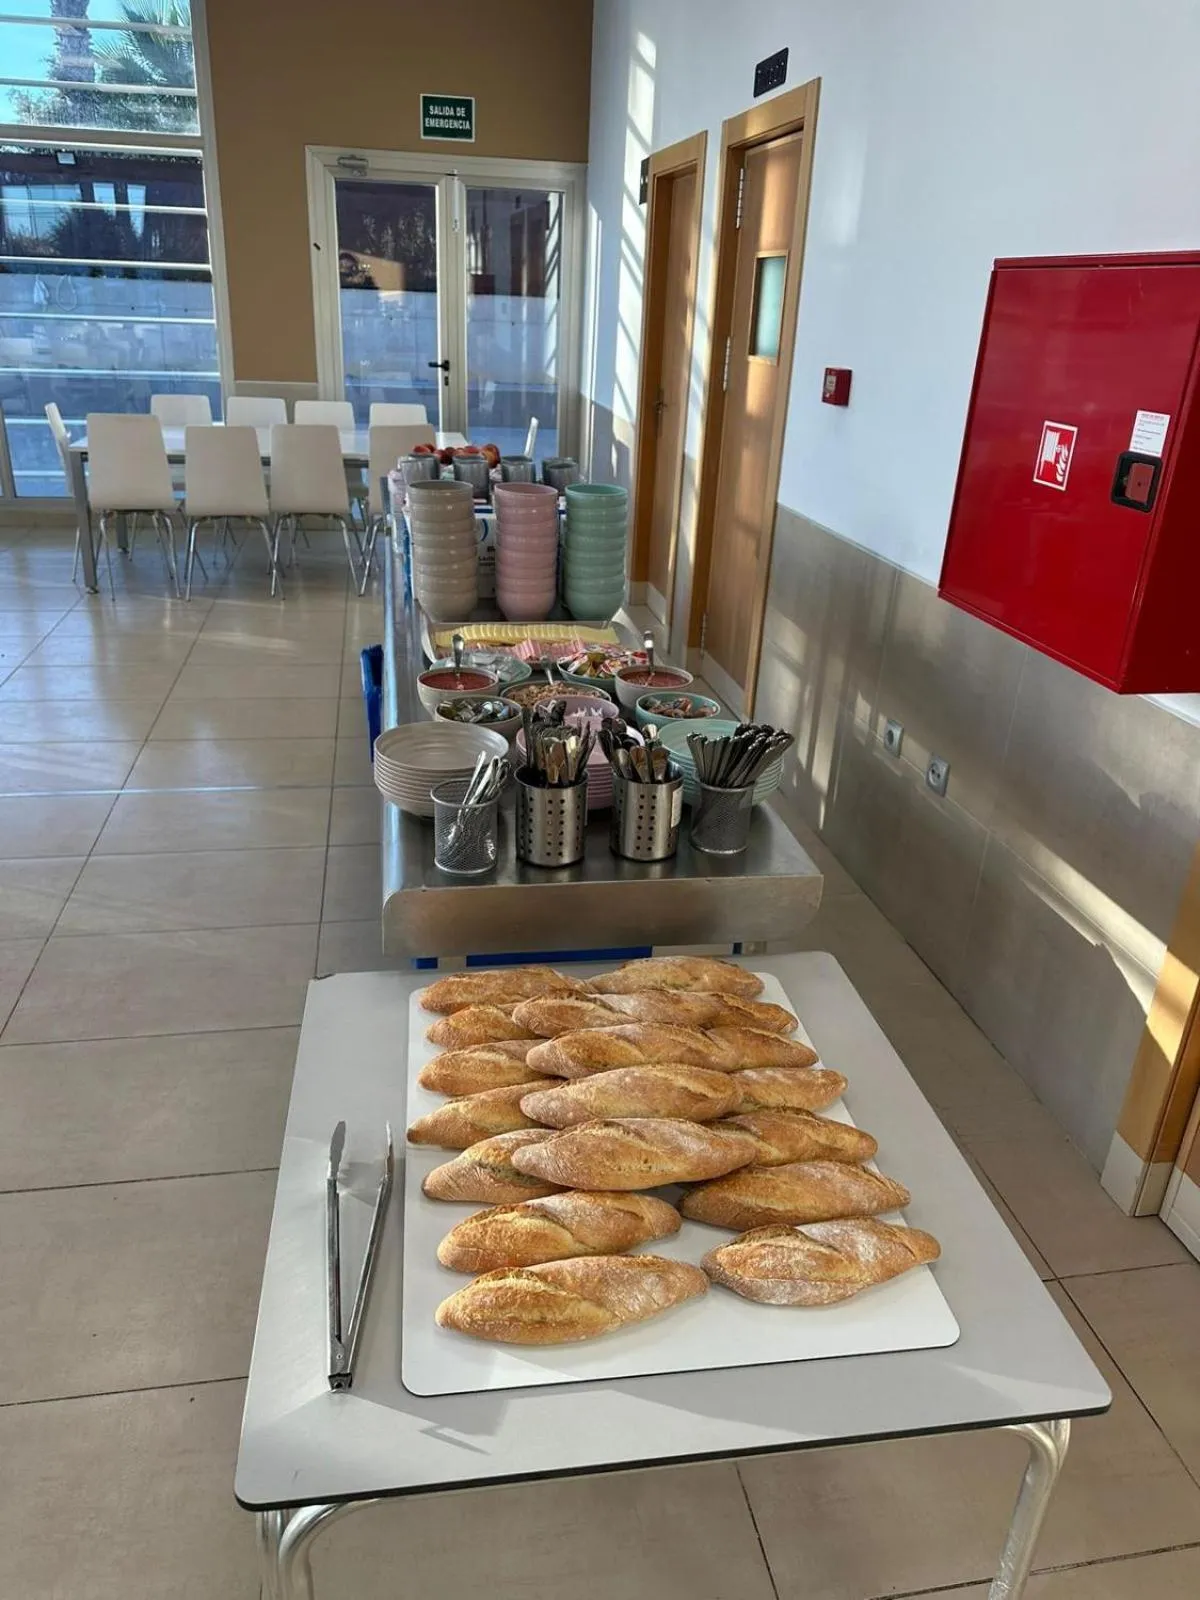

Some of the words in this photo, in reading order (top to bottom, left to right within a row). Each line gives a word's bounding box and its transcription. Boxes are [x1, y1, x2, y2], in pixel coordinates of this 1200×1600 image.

[429, 105, 455, 116] SALIDA
[456, 107, 466, 117] DE
[425, 117, 471, 130] EMERGENCIA
